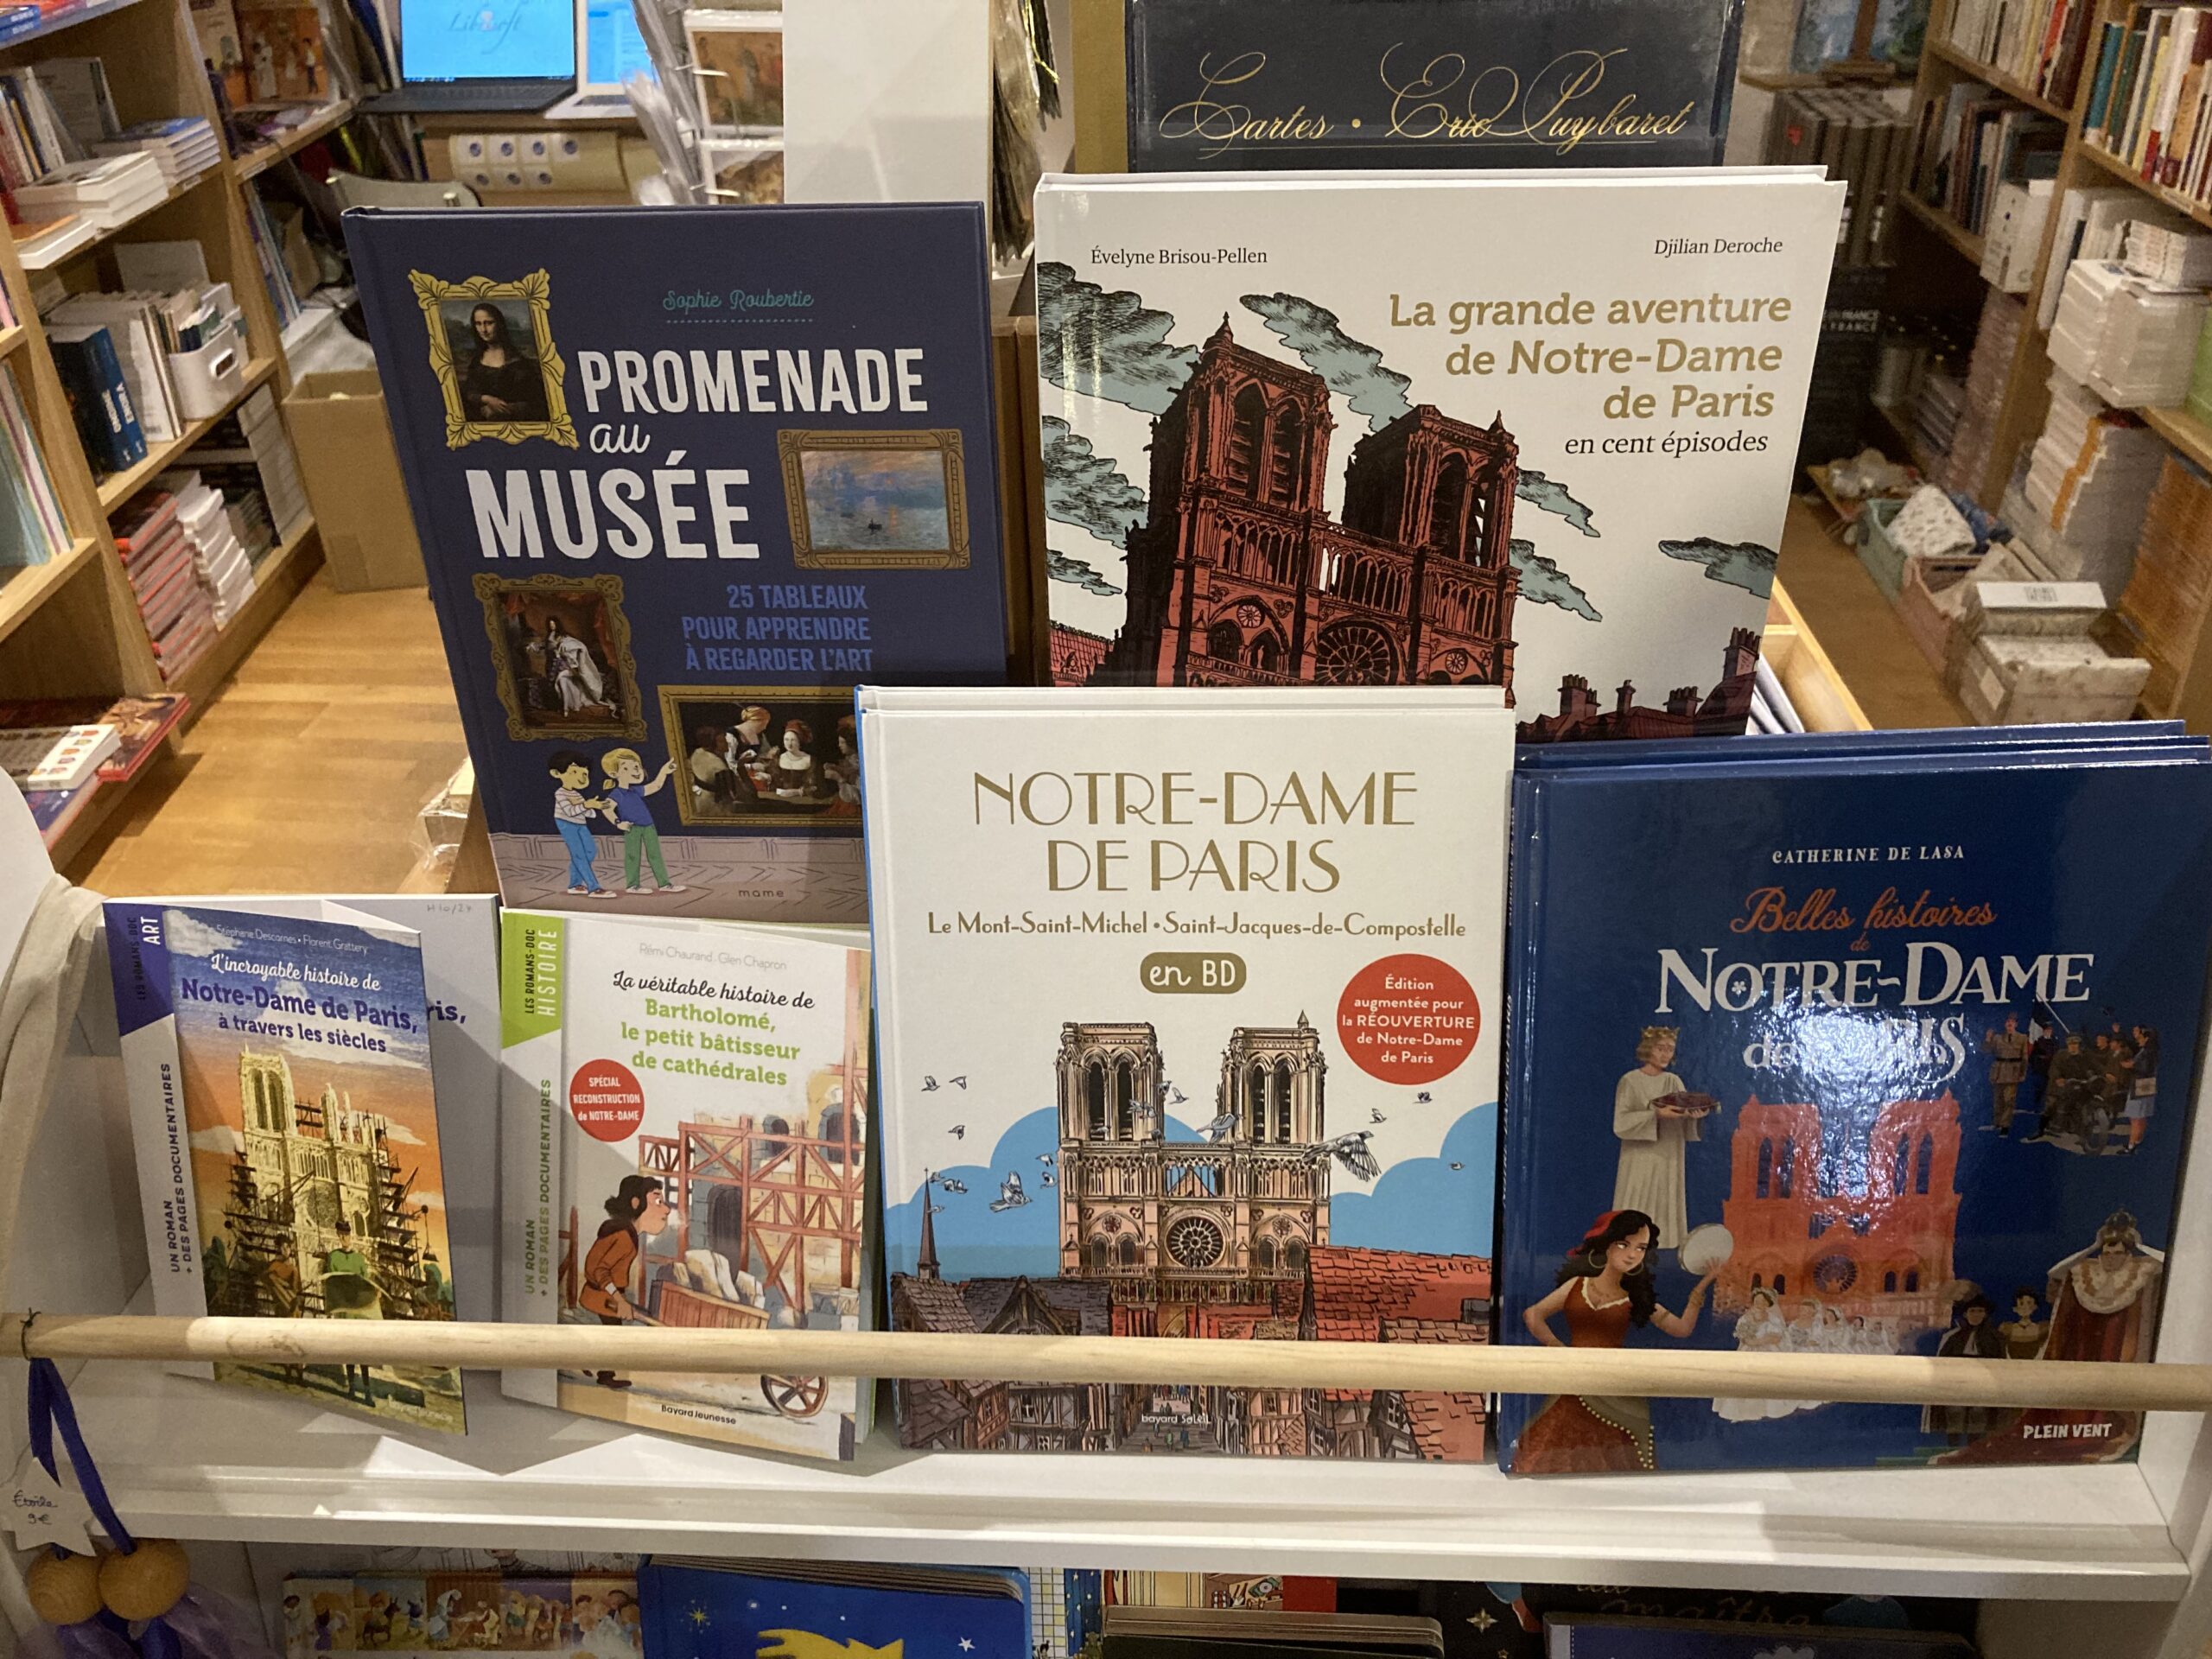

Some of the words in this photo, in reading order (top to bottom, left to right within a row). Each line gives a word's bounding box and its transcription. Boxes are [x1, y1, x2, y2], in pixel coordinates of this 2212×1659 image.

[1159, 51, 1334, 160] Cartes
[1469, 48, 1695, 156] Puybaret
[1091, 245, 1155, 268] Évelyne
[1159, 248, 1268, 264] Brisou-Pellen
[1654, 239, 1709, 257] Djilian
[1713, 238, 1783, 254] Deroche
[663, 289, 722, 315] Sophie
[729, 288, 815, 312] Roubertie
[1389, 295, 1435, 327] La
[1448, 293, 1595, 334] grande
[1607, 293, 1792, 325] aventure
[1446, 344, 1495, 376] de
[1507, 339, 1783, 374] Notre-Dame
[577, 347, 929, 414] PROMENADE
[1603, 386, 1656, 420] de
[1671, 384, 1776, 418] Paris
[589, 423, 652, 454] au
[1565, 436, 1595, 454] en
[1602, 435, 1656, 454] cent
[1661, 431, 1769, 459] épisodes
[466, 448, 760, 560] MUSÉE
[727, 585, 754, 609] 25
[759, 585, 869, 610] TABLEAUX
[681, 616, 741, 640] POUR
[746, 617, 872, 641] APPRENDRE
[684, 643, 701, 671] À
[704, 647, 817, 671] REGARDER
[821, 648, 874, 672] L'ART
[974, 771, 1418, 827] NOTRE-DAME
[1047, 839, 1129, 892] DE
[1150, 838, 1341, 893] PARIS
[1771, 848, 1880, 864] CATHERINE
[1888, 847, 1912, 861] DE
[1919, 845, 1965, 860] LASA
[1729, 886, 1856, 933] Belles
[1863, 886, 1998, 930] histoires
[140, 916, 162, 945] ART
[928, 912, 952, 934] Le
[957, 911, 1147, 934] Mont-Saint-Michel
[1162, 910, 1466, 941] Saint-Jacques-de-Compostelle
[1850, 931, 1871, 951] de
[211, 953, 302, 982] L'incroyable
[304, 964, 360, 989] histoire
[362, 974, 381, 991] de
[525, 929, 536, 995] ROMANS-DOC
[537, 930, 557, 1017] HISTOIRE
[1149, 965, 1192, 987] en
[1202, 959, 1236, 987] BD
[613, 970, 635, 991] La
[639, 976, 717, 998] véritable
[720, 982, 789, 1007] histoire
[792, 991, 816, 1009] de
[1384, 973, 1434, 990] Édition
[1654, 941, 2094, 1014] NOTRE-DAME
[181, 978, 316, 1016] Notre-Dame
[321, 995, 349, 1020] de
[353, 1000, 418, 1034] Paris,
[426, 1000, 466, 1024] ris,
[524, 997, 535, 1014] LES
[645, 998, 776, 1033] Bartholomé,
[1354, 996, 1428, 1012] augmentée
[1433, 1001, 1465, 1013] pour
[219, 1013, 229, 1029] à
[233, 1015, 294, 1039] travers
[298, 1023, 323, 1043] les
[327, 1029, 387, 1053] siècles
[1342, 1014, 1353, 1027] la
[1357, 1012, 1476, 1029] RÉOUVERTURE
[620, 1021, 640, 1040] le
[645, 1028, 694, 1047] petit
[700, 1032, 801, 1061] bâtisseur
[1357, 1033, 1373, 1045] de
[1377, 1032, 1464, 1046] Notre-Dame
[632, 1051, 657, 1069] de
[663, 1058, 788, 1086] cathédrales
[1381, 1051, 1397, 1063] de
[1402, 1051, 1434, 1064] Paris
[588, 1074, 621, 1087] SPÉCIAL
[573, 1093, 640, 1104] RECONSTRUCTION
[161, 1064, 183, 1184] DOCUMENTAIRES
[578, 1110, 588, 1122] de
[588, 1110, 640, 1121] NOTRE-DAME
[539, 1078, 551, 1204] DOCUMENTAIRES
[175, 1188, 188, 1231] PAGES
[163, 1200, 177, 1251] ROMAN
[539, 1207, 550, 1254] PAGES
[181, 1236, 192, 1262] DES
[524, 1218, 536, 1272] ROMAN
[171, 1253, 181, 1273] UN
[539, 1255, 550, 1285] DES
[524, 1273, 536, 1295] UN
[661, 1404, 694, 1417] Bayard
[694, 1410, 737, 1425] Jeunesse
[2023, 1424, 2069, 1440] PLEIN
[2072, 1422, 2113, 1438] VENT
